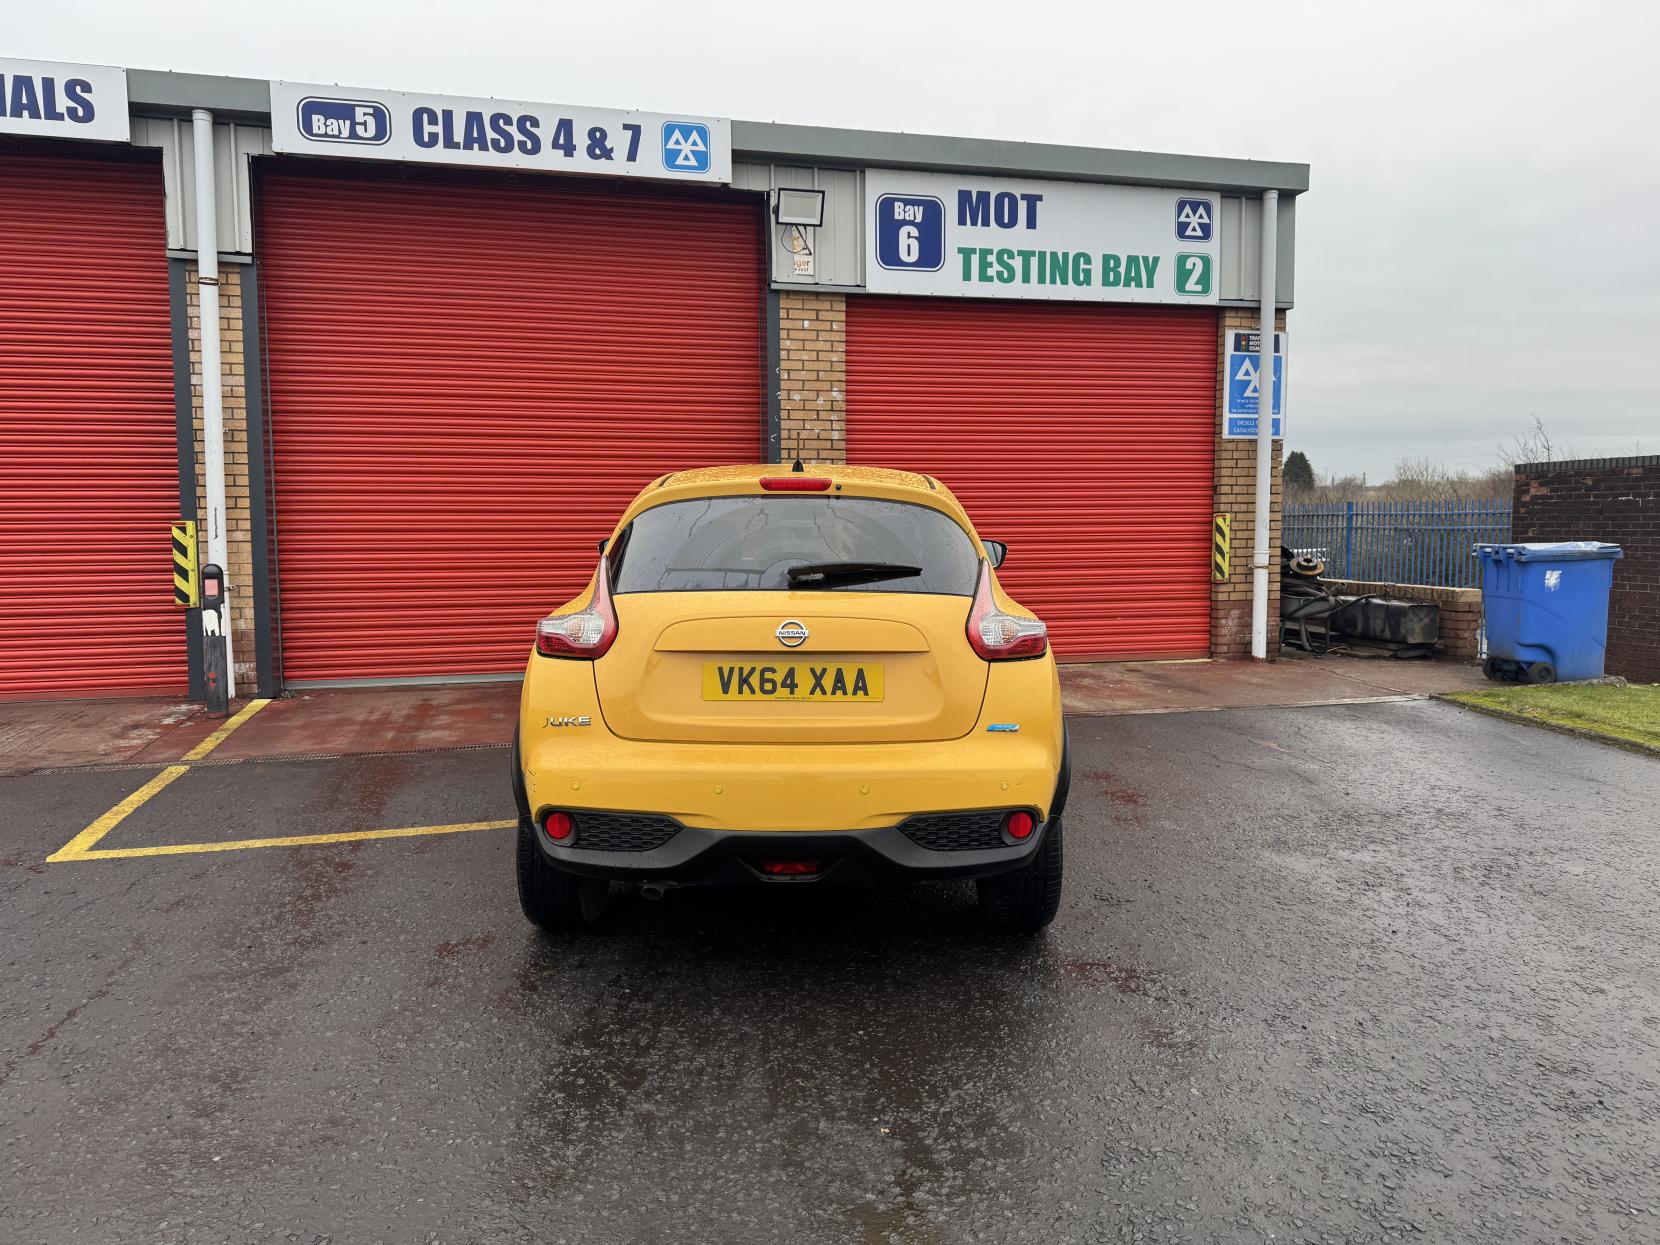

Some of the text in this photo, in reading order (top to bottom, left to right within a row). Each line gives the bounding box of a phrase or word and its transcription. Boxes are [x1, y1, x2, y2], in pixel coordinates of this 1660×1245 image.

[312, 107, 376, 139] Bay 5
[412, 106, 642, 162] CLASS 4 & 7
[894, 201, 924, 223] Bay
[957, 189, 1044, 230] MOT
[898, 225, 920, 263] 6
[957, 246, 1161, 289] TESTING BAY
[1184, 256, 1204, 292] 2
[717, 666, 869, 696] VK64 XAA
[541, 716, 592, 728] JUKE
